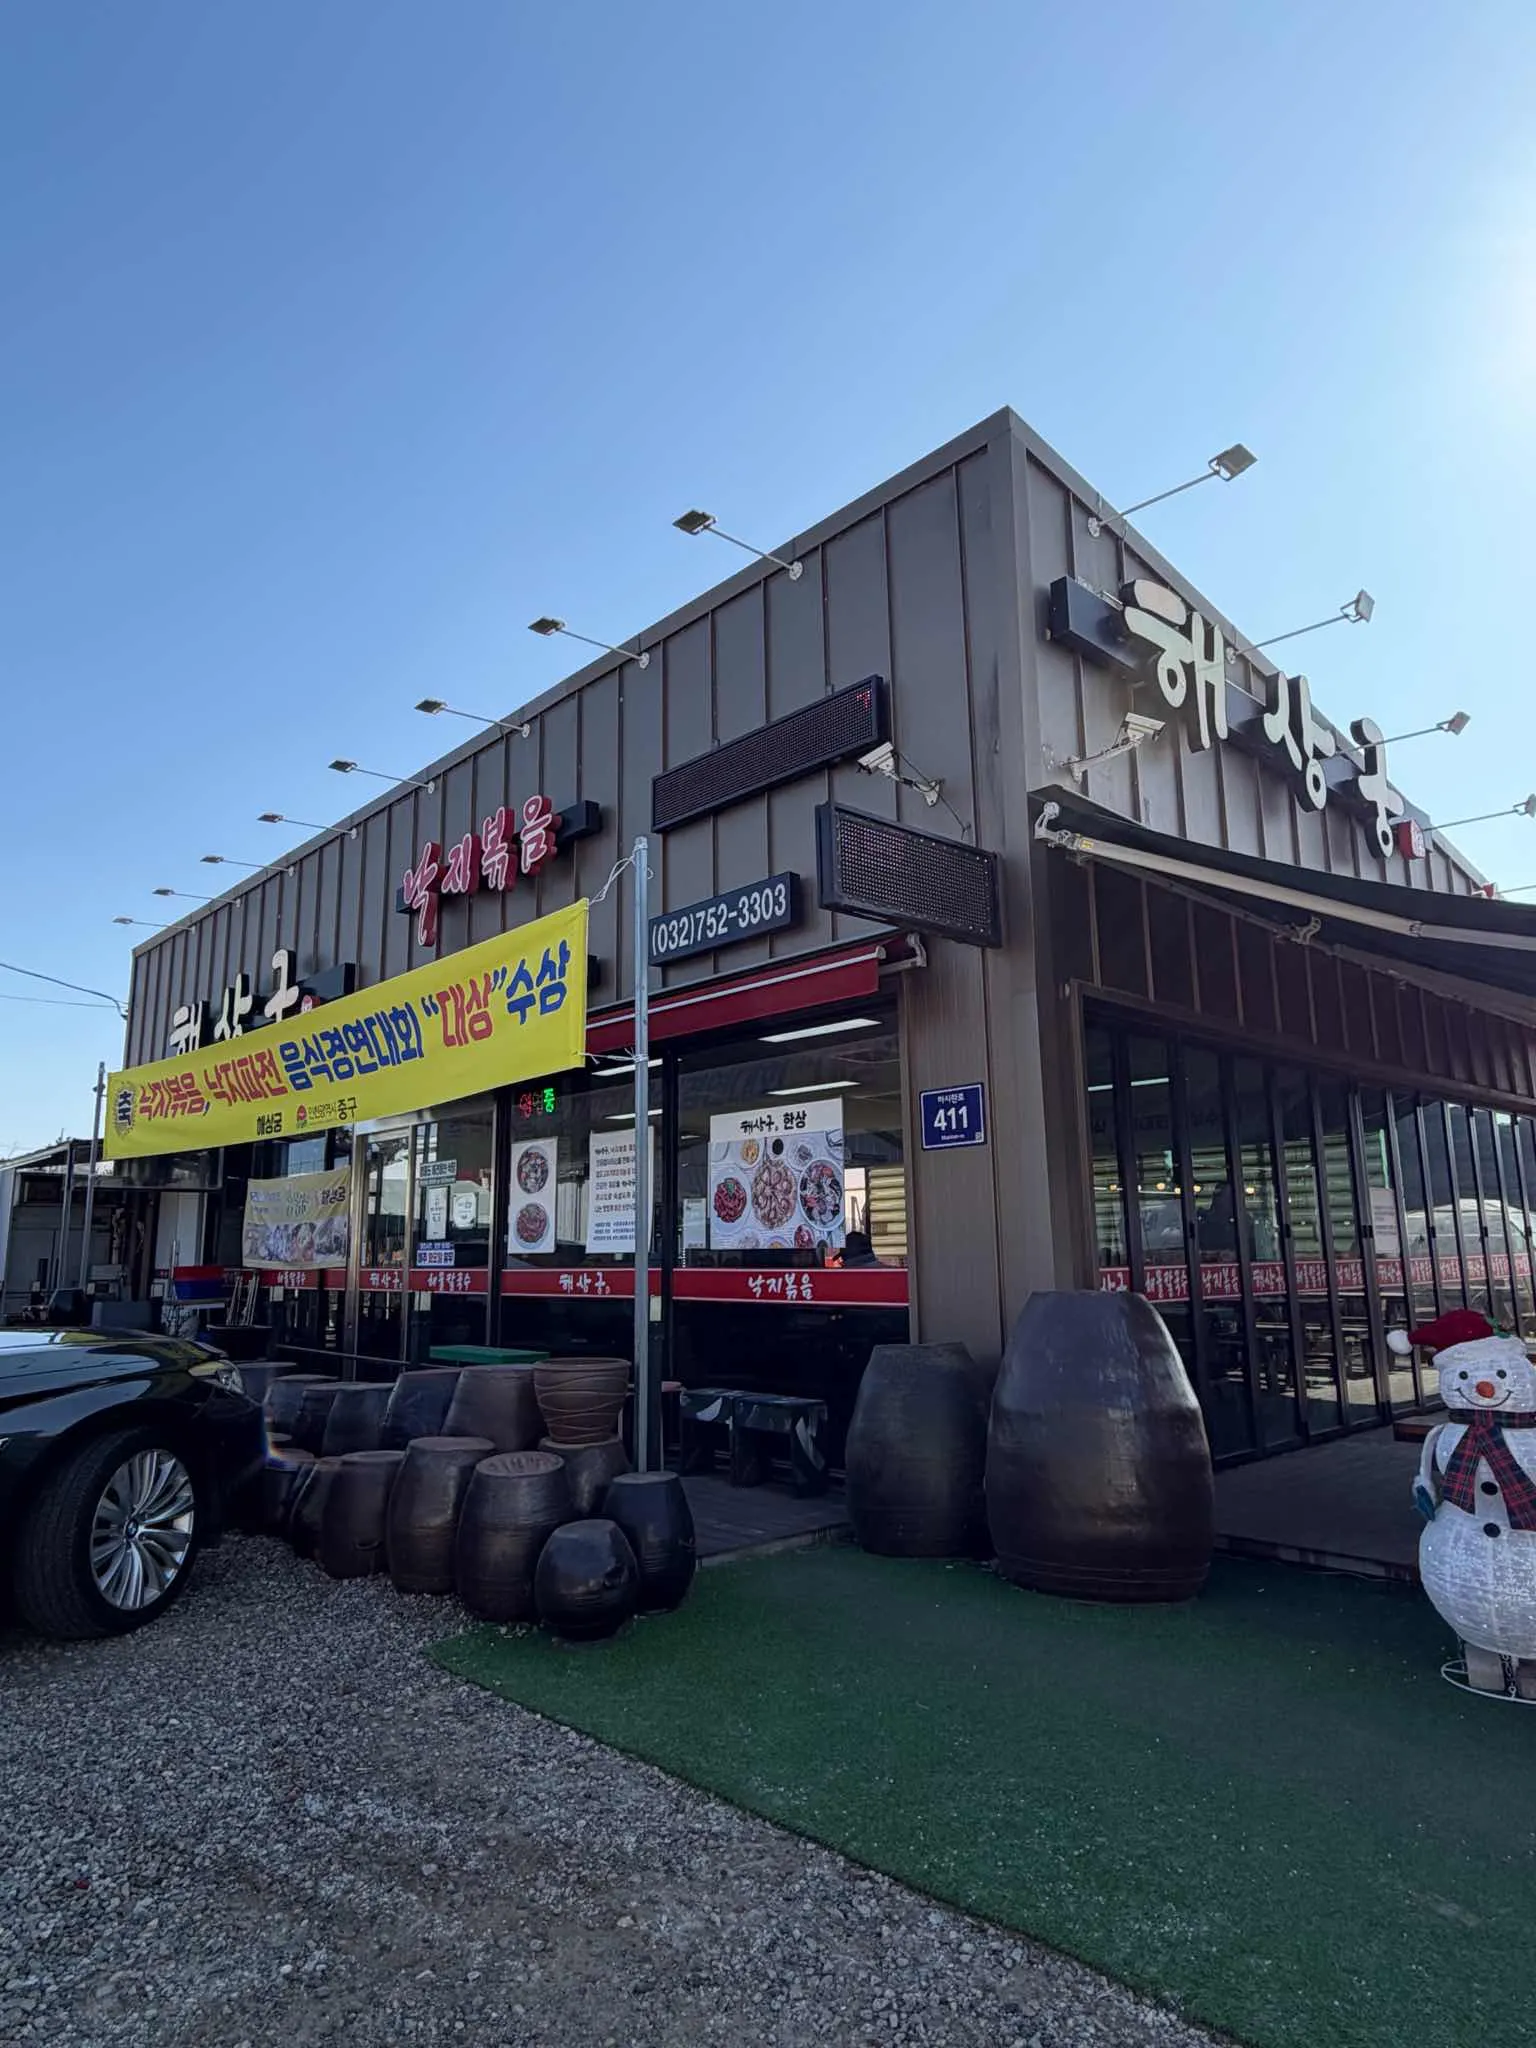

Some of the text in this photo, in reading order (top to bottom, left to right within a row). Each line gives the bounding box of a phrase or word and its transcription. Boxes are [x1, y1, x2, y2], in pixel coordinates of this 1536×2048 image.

[1123, 579, 1405, 859] 해상궁
[403, 795, 553, 946] 낙지볶음
[652, 883, 787, 956] (032)752-3303
[203, 1048, 288, 1106] 낙지파전
[279, 1001, 424, 1091] 음식경연대회
[338, 1097, 358, 1121] 중구
[783, 1110, 807, 1130] 한상
[934, 1106, 968, 1131] 411
[748, 1273, 815, 1300] 낙지볶음
